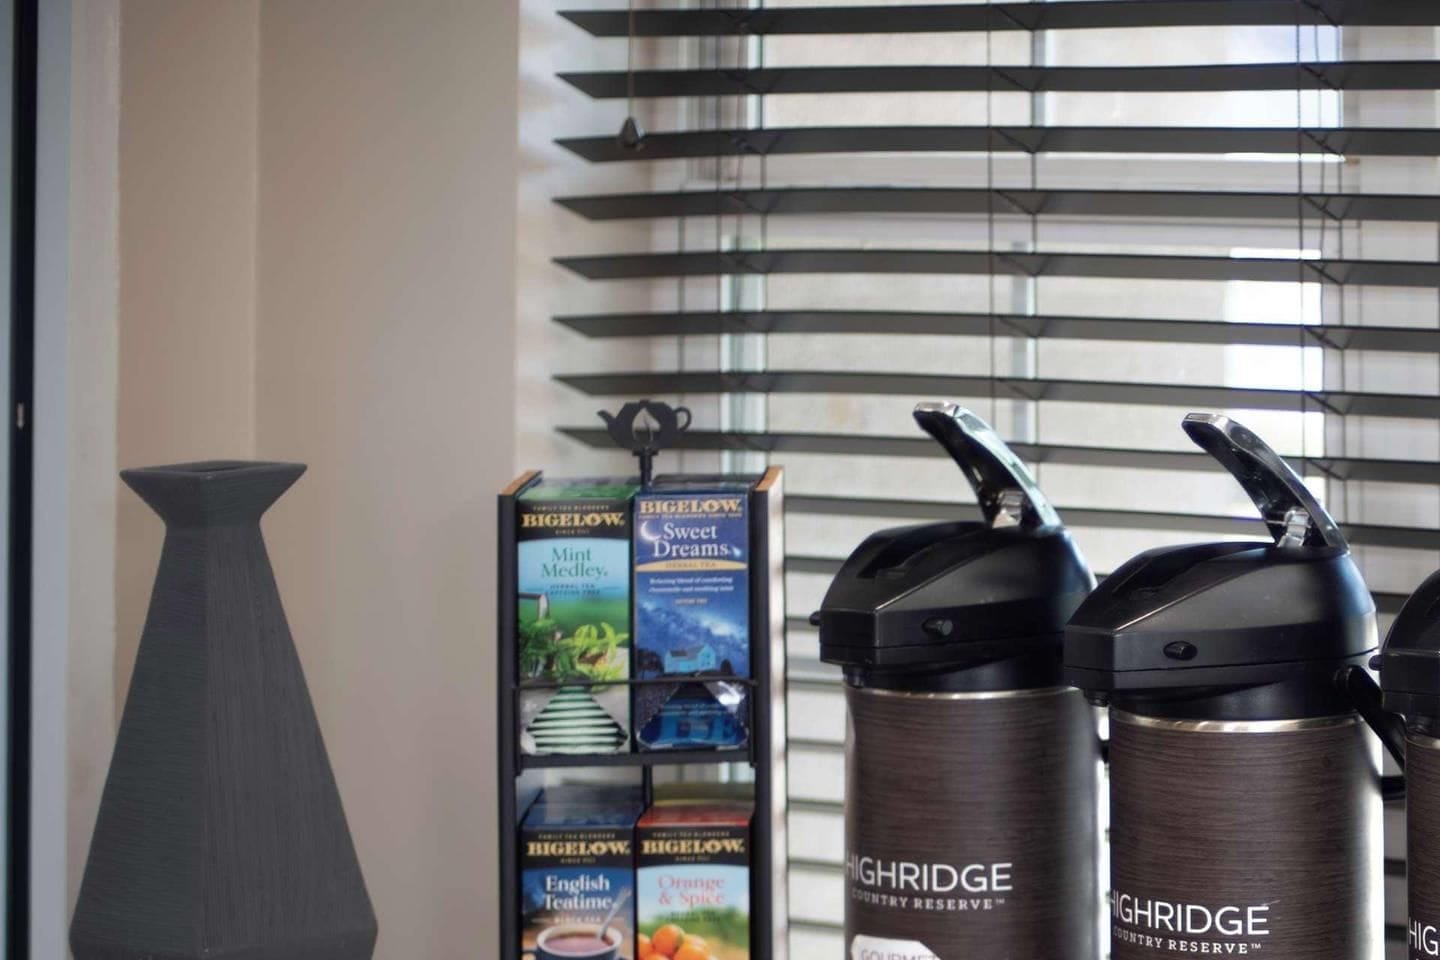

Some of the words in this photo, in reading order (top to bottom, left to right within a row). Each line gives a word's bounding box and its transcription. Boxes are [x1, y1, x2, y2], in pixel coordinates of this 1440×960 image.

[663, 522, 718, 540] Sweet
[551, 546, 592, 562] Mint
[653, 540, 728, 557] Dreams
[541, 562, 604, 580] Medley
[846, 852, 1014, 893] HIGHRIDGE
[545, 873, 611, 896] English
[657, 875, 726, 892] Orange
[544, 894, 612, 911] Teatime
[658, 891, 672, 905] &
[679, 891, 725, 908] Spice
[851, 888, 909, 909] COUNTRY
[1113, 925, 1164, 949] COUNTRY
